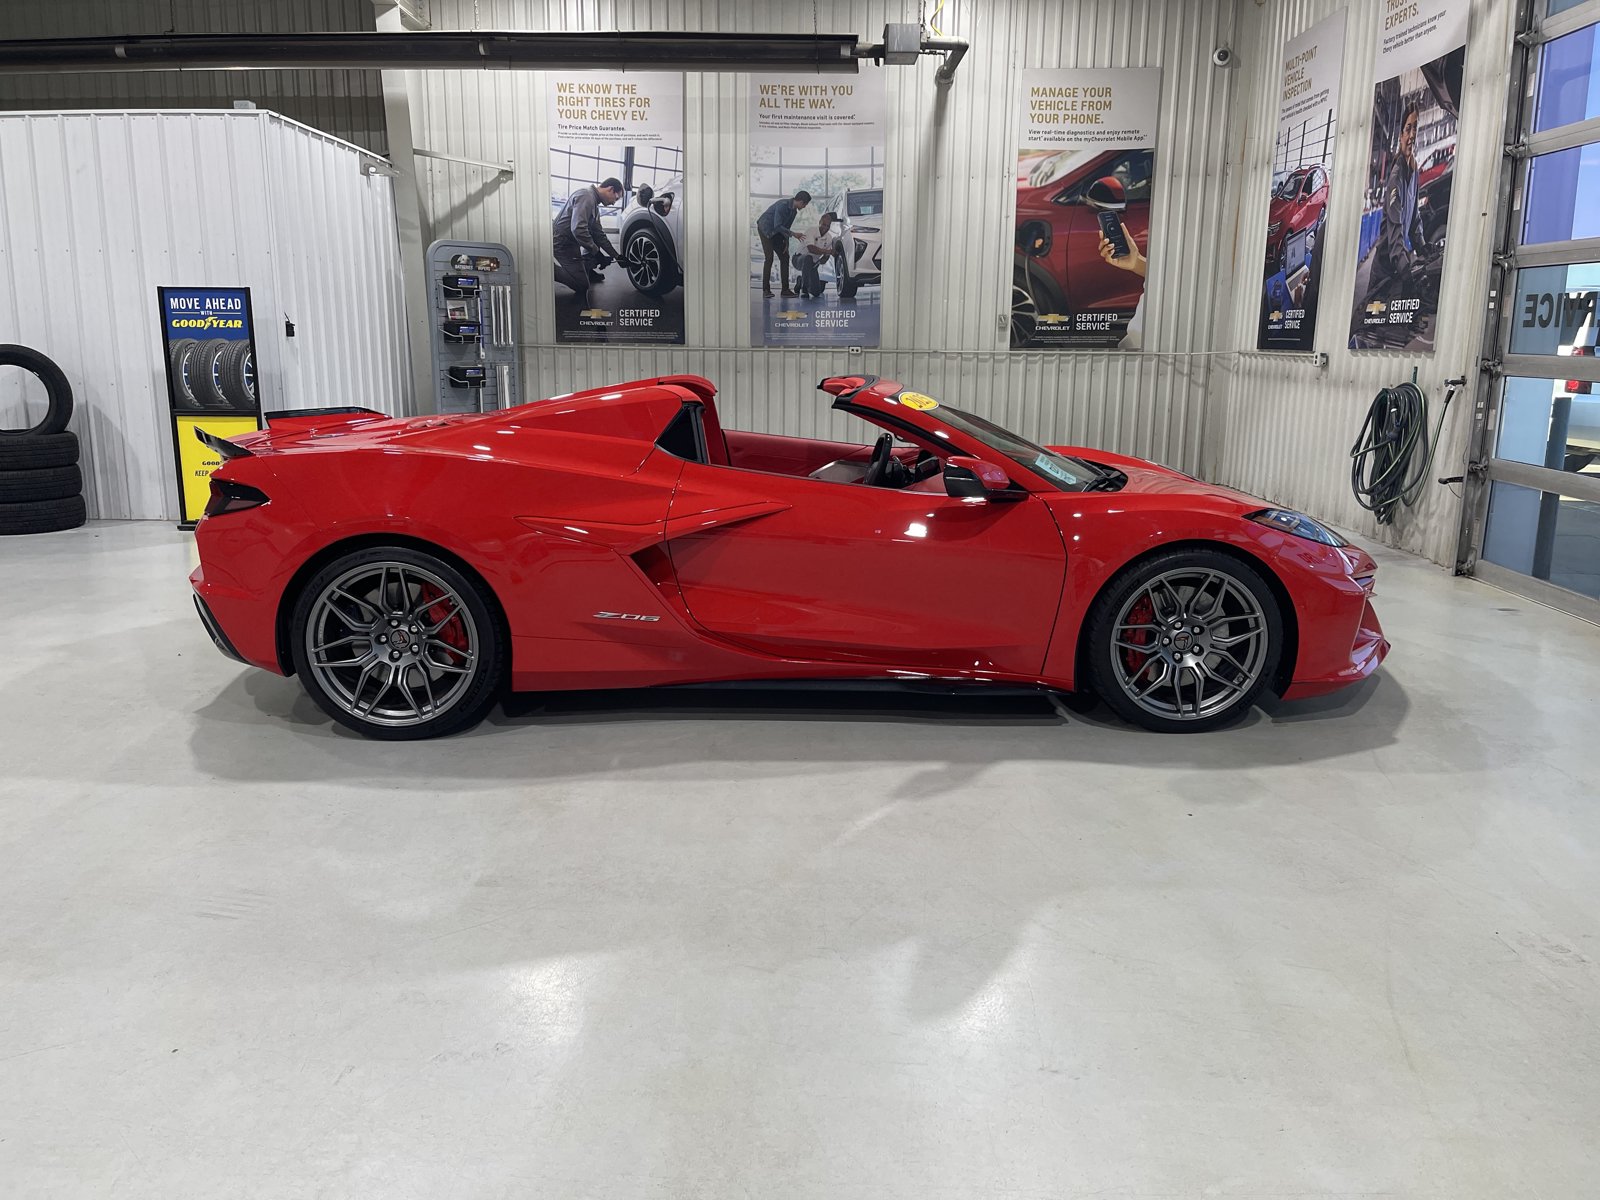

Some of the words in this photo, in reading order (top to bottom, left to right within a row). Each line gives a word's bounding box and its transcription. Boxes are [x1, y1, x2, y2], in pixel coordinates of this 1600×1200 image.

[1384, 2, 1419, 30] EXPERTS.
[1285, 46, 1317, 71] MULTI-POINT
[1284, 67, 1304, 87] VEHICLE
[557, 82, 575, 94] WE
[578, 83, 612, 95] KNOW
[615, 84, 637, 95] THE
[760, 84, 795, 96] WE'RE
[798, 85, 828, 96] WITH
[830, 85, 854, 96] YOU
[1031, 86, 1079, 98] MANAGE
[1082, 87, 1112, 98] YOUR
[1282, 77, 1312, 101] INSPECTION
[557, 96, 591, 107] RIGHT
[594, 97, 626, 108] TIRES
[629, 98, 651, 108] FOR
[759, 98, 781, 109] ALL
[784, 98, 806, 109] THE
[808, 98, 836, 109] WAY.
[1030, 100, 1078, 111] VEHICLE
[1080, 100, 1112, 111] FROM
[557, 108, 587, 120] YOUR
[590, 109, 628, 121] CHEVY
[631, 110, 648, 121] EV.
[1029, 112, 1060, 124] YOUR
[1062, 113, 1105, 125] PHONE.
[1066, 129, 1096, 137] diagnostics
[1106, 129, 1121, 137] enjoy
[170, 297, 201, 310] MOVE
[205, 297, 242, 310] AHEAD
[1390, 298, 1420, 311] CERTIFIED
[619, 309, 661, 318] CERTIFIED
[815, 310, 856, 319] CERTIFIED
[1076, 313, 1118, 322] CERTIFIED
[1285, 309, 1306, 319] CERTIFIED
[1388, 311, 1414, 324] SERVICE
[172, 317, 243, 330] GOODYEAR
[619, 318, 653, 327] SERVICE
[815, 319, 849, 328] SERVICE
[1075, 322, 1111, 331] SERVICE
[1284, 320, 1301, 330] SERVICE
[592, 611, 661, 622] Z06
